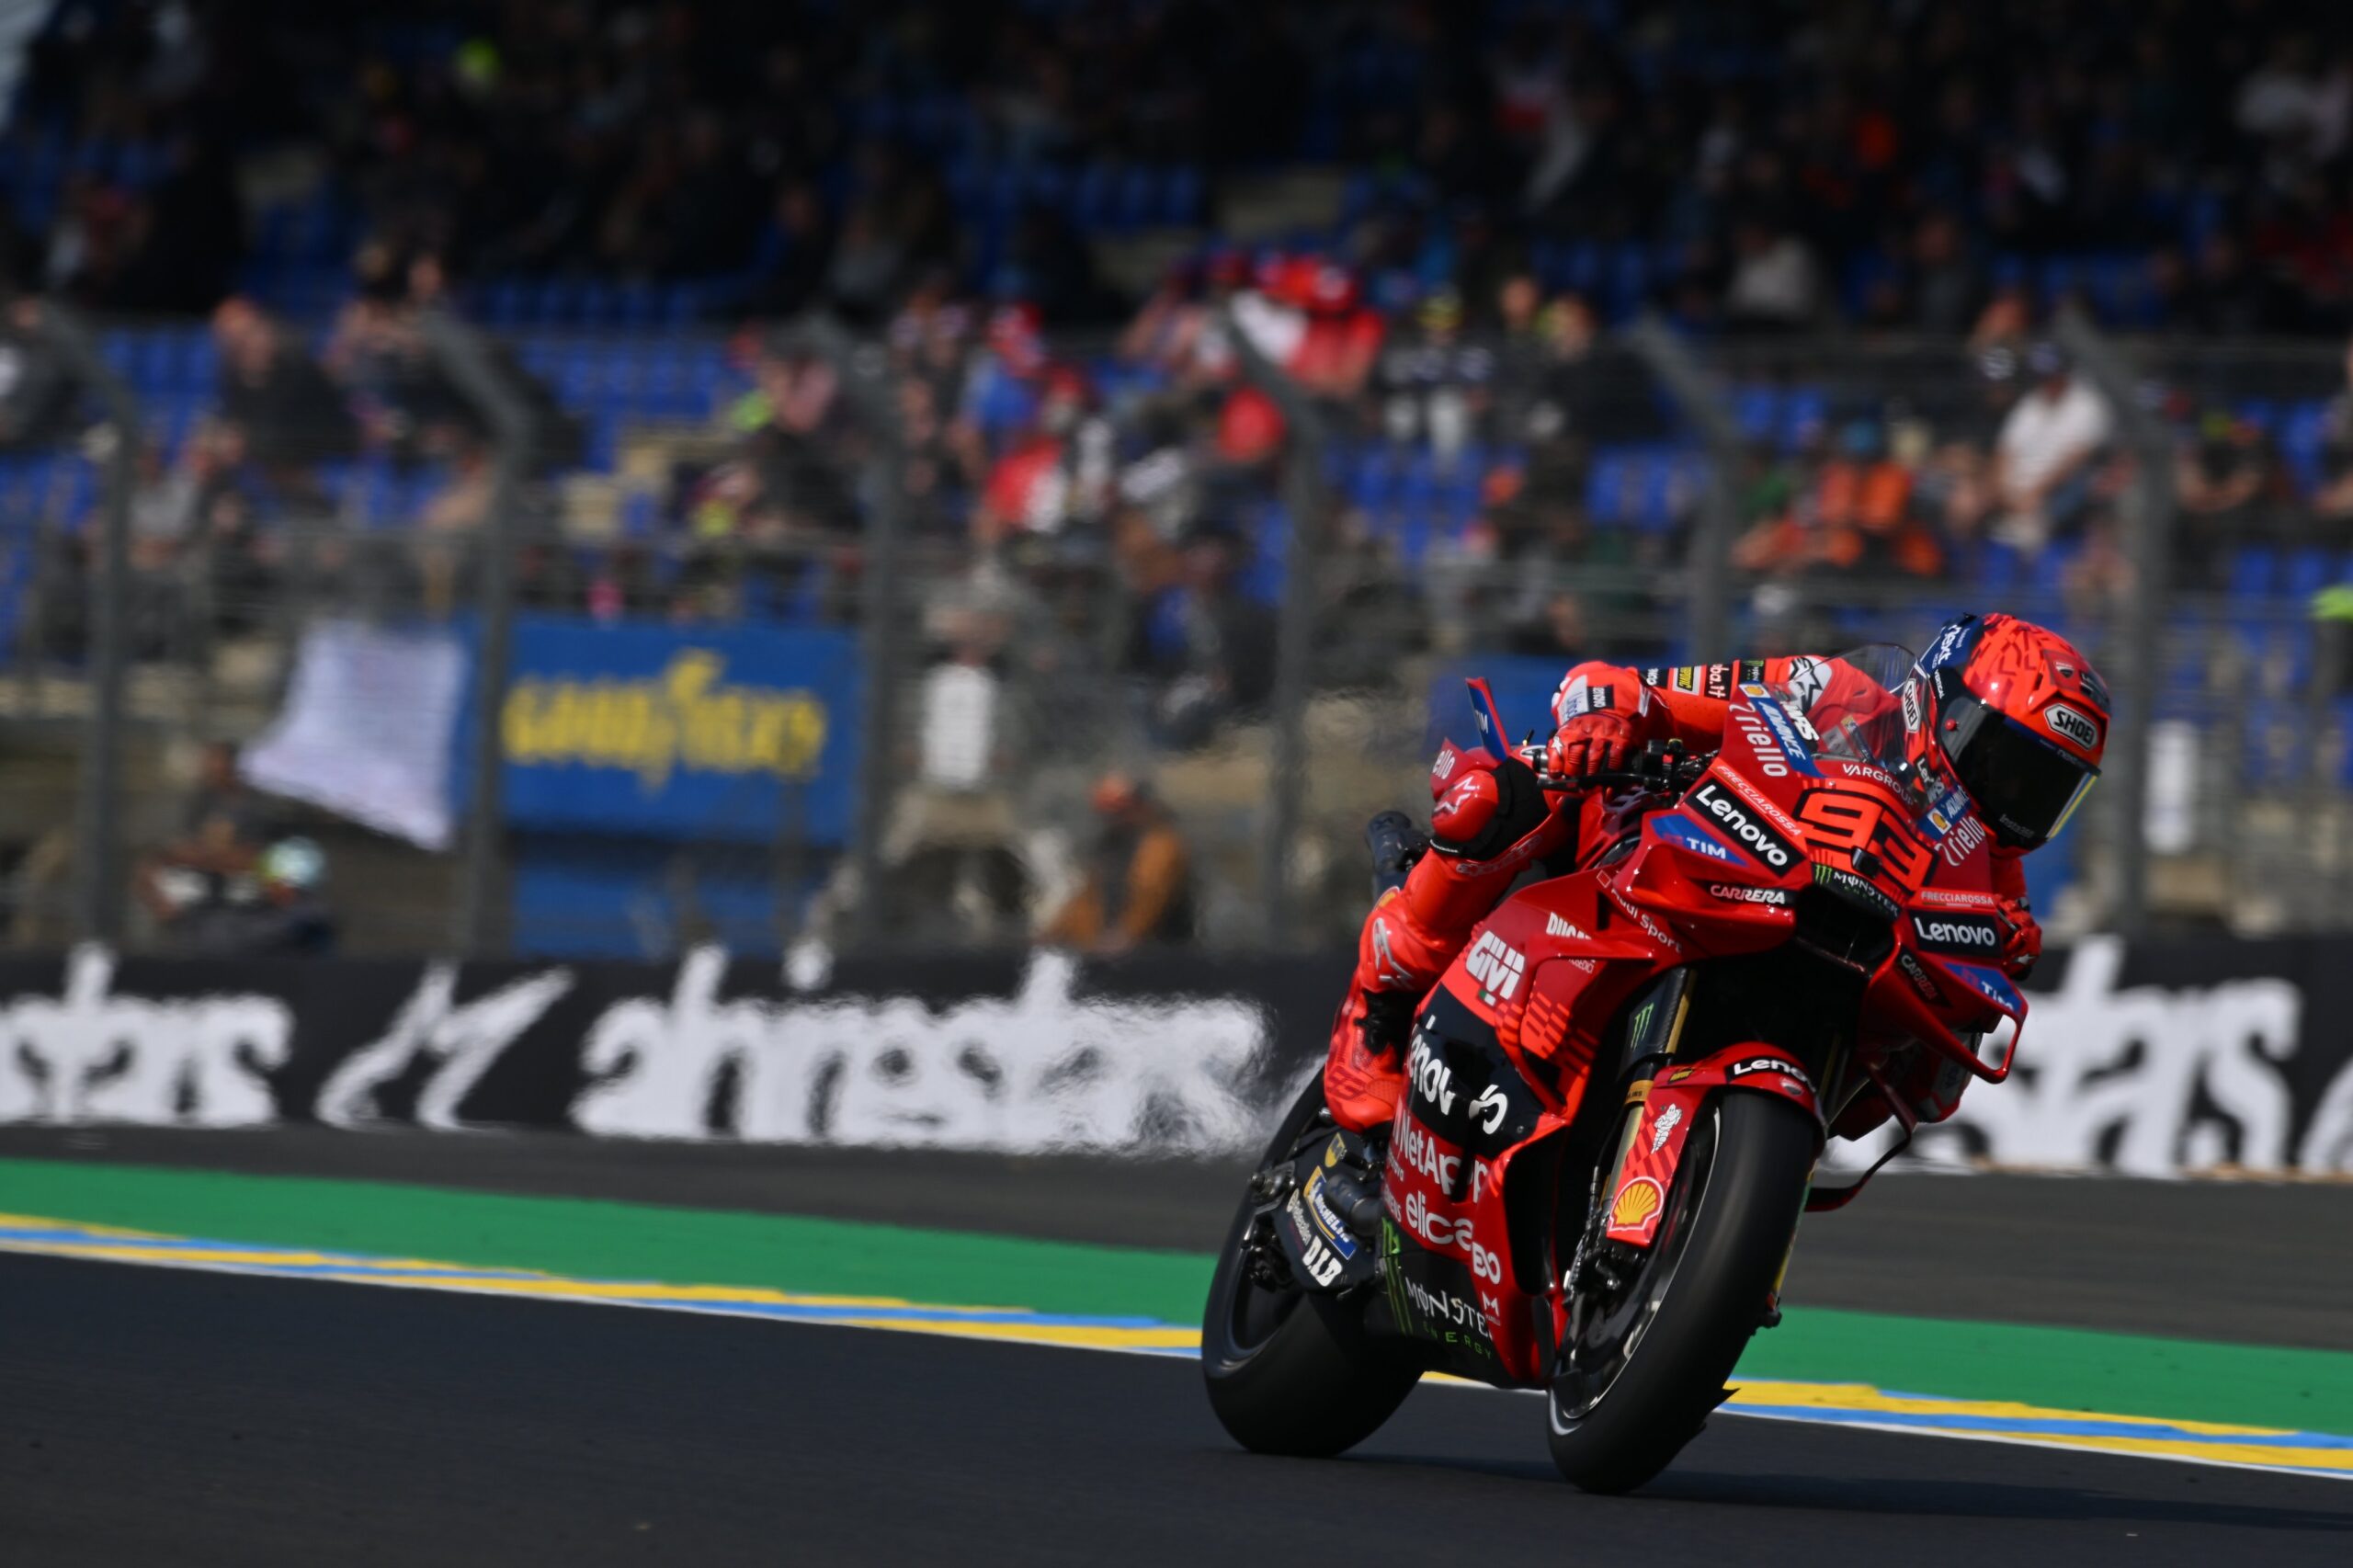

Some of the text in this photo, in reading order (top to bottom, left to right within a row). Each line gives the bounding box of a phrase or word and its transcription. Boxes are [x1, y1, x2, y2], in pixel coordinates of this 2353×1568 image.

[2053, 710, 2096, 745] SHOEI
[1716, 765, 1802, 837] FRECCIAROSSA
[1842, 763, 1915, 807] VARGROUP
[1695, 784, 1789, 867] Lenovo
[1686, 836, 1727, 860] TIM
[1710, 883, 1786, 905] CARRERA
[1920, 890, 1995, 905] FRECCIAROSSA
[1639, 913, 1683, 954] Sport
[1914, 916, 1995, 947] Lenovo
[1465, 929, 1526, 1000] GIVI
[1397, 1107, 1490, 1205] NetApp
[1405, 1276, 1493, 1342] MONSTE
